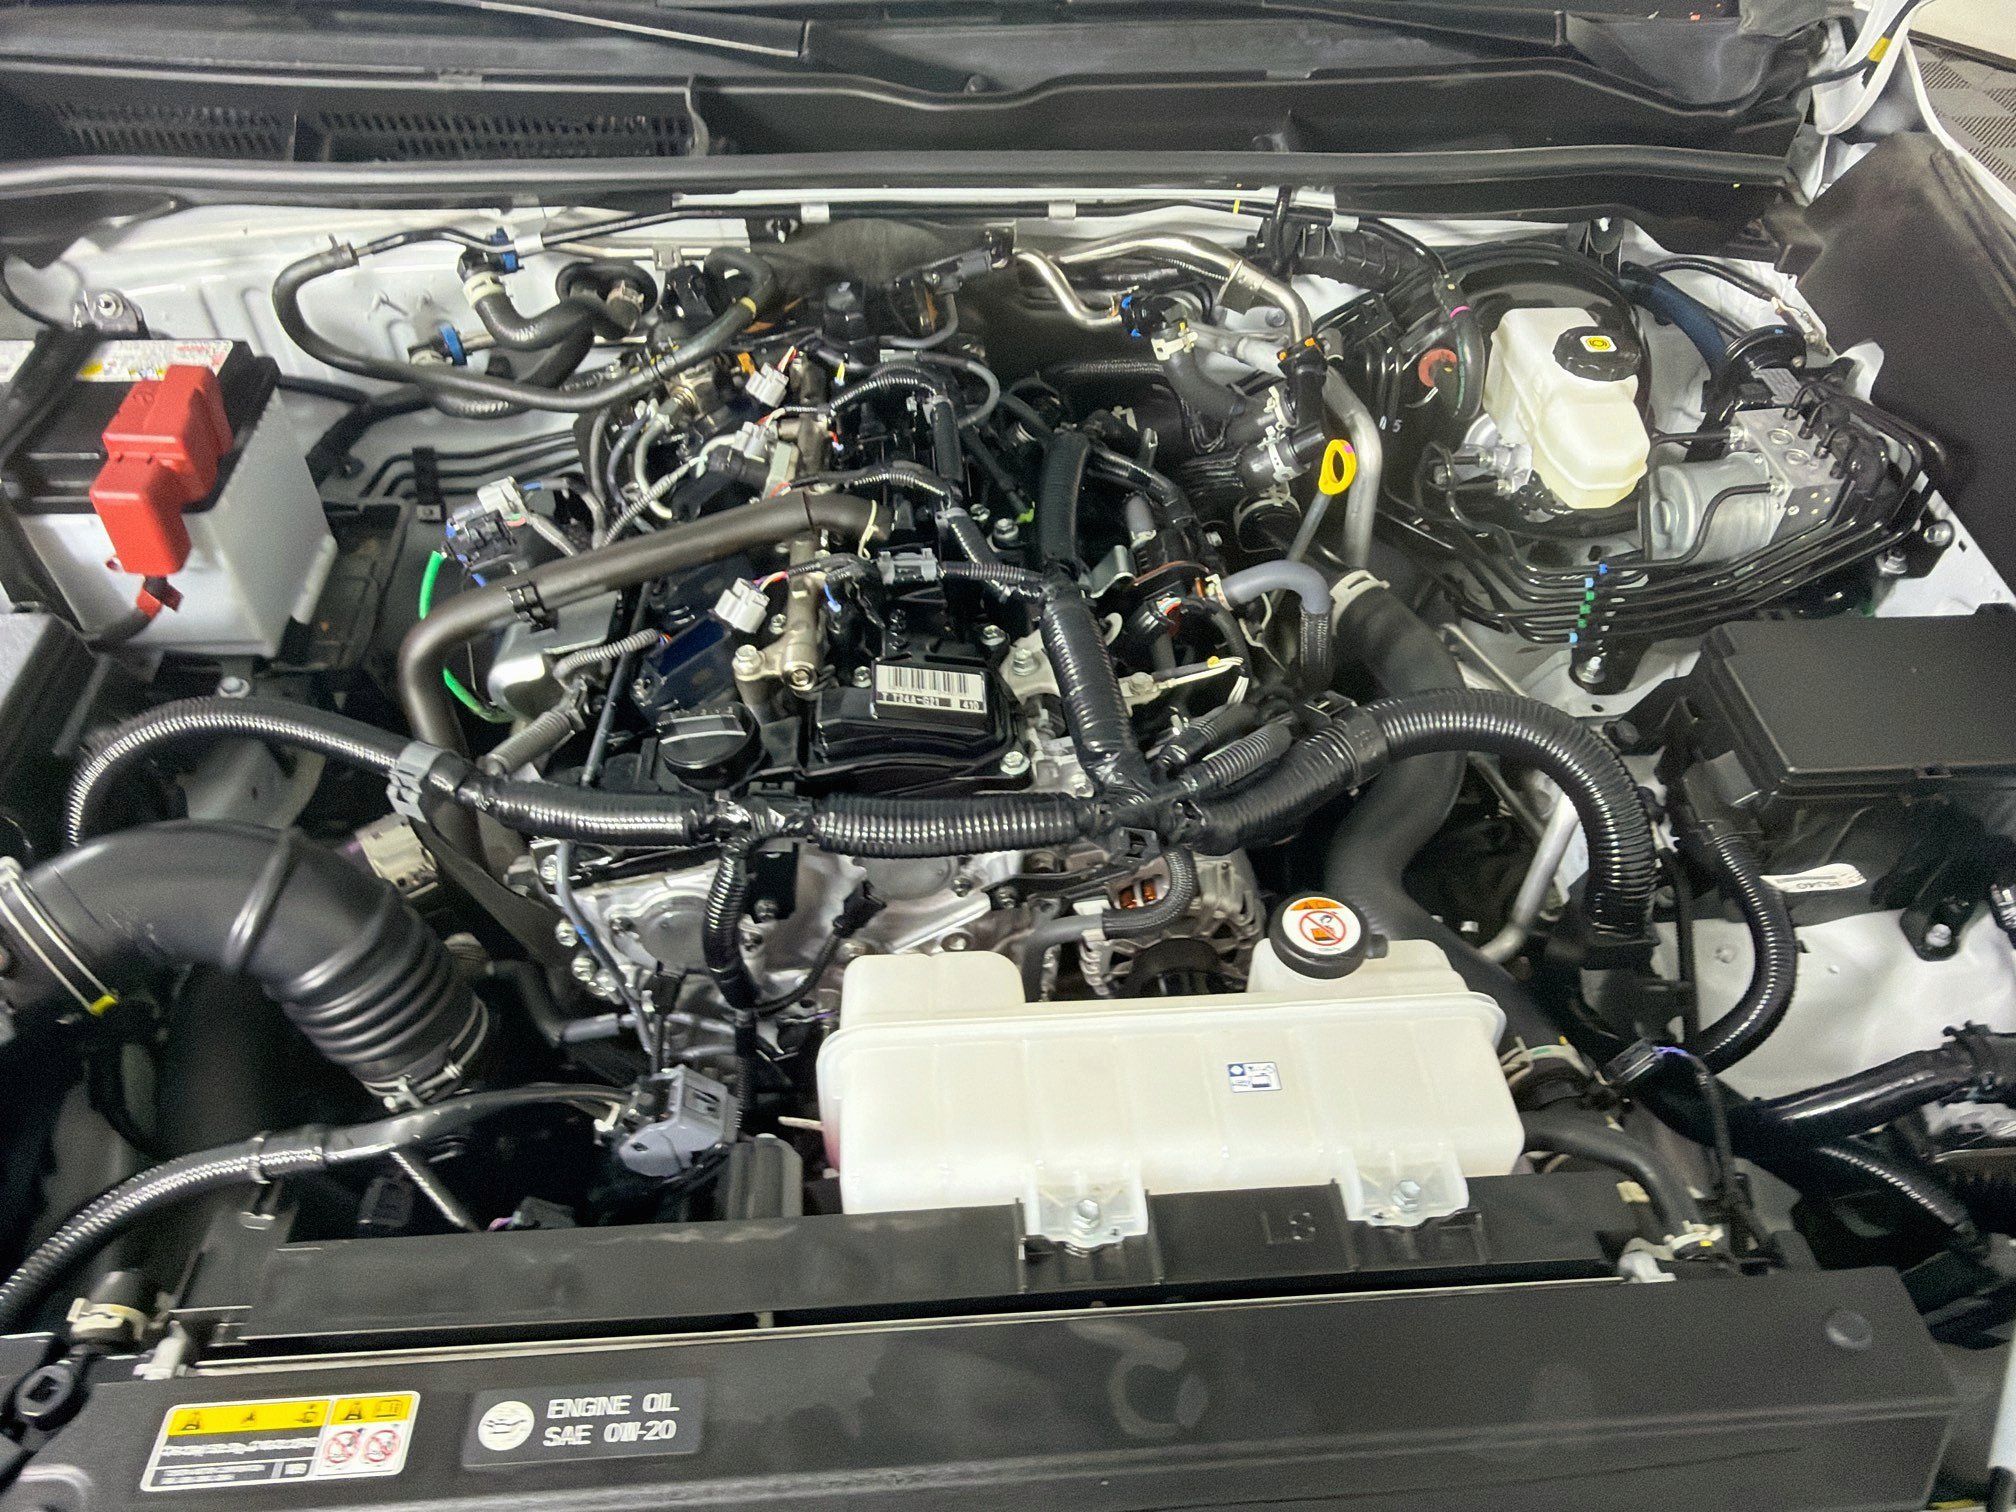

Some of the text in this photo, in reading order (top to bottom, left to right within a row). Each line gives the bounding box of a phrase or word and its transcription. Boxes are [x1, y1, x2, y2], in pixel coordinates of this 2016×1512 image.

[546, 1392, 680, 1419] ENGINE OIL
[542, 1419, 677, 1447] SAE 0W-20
